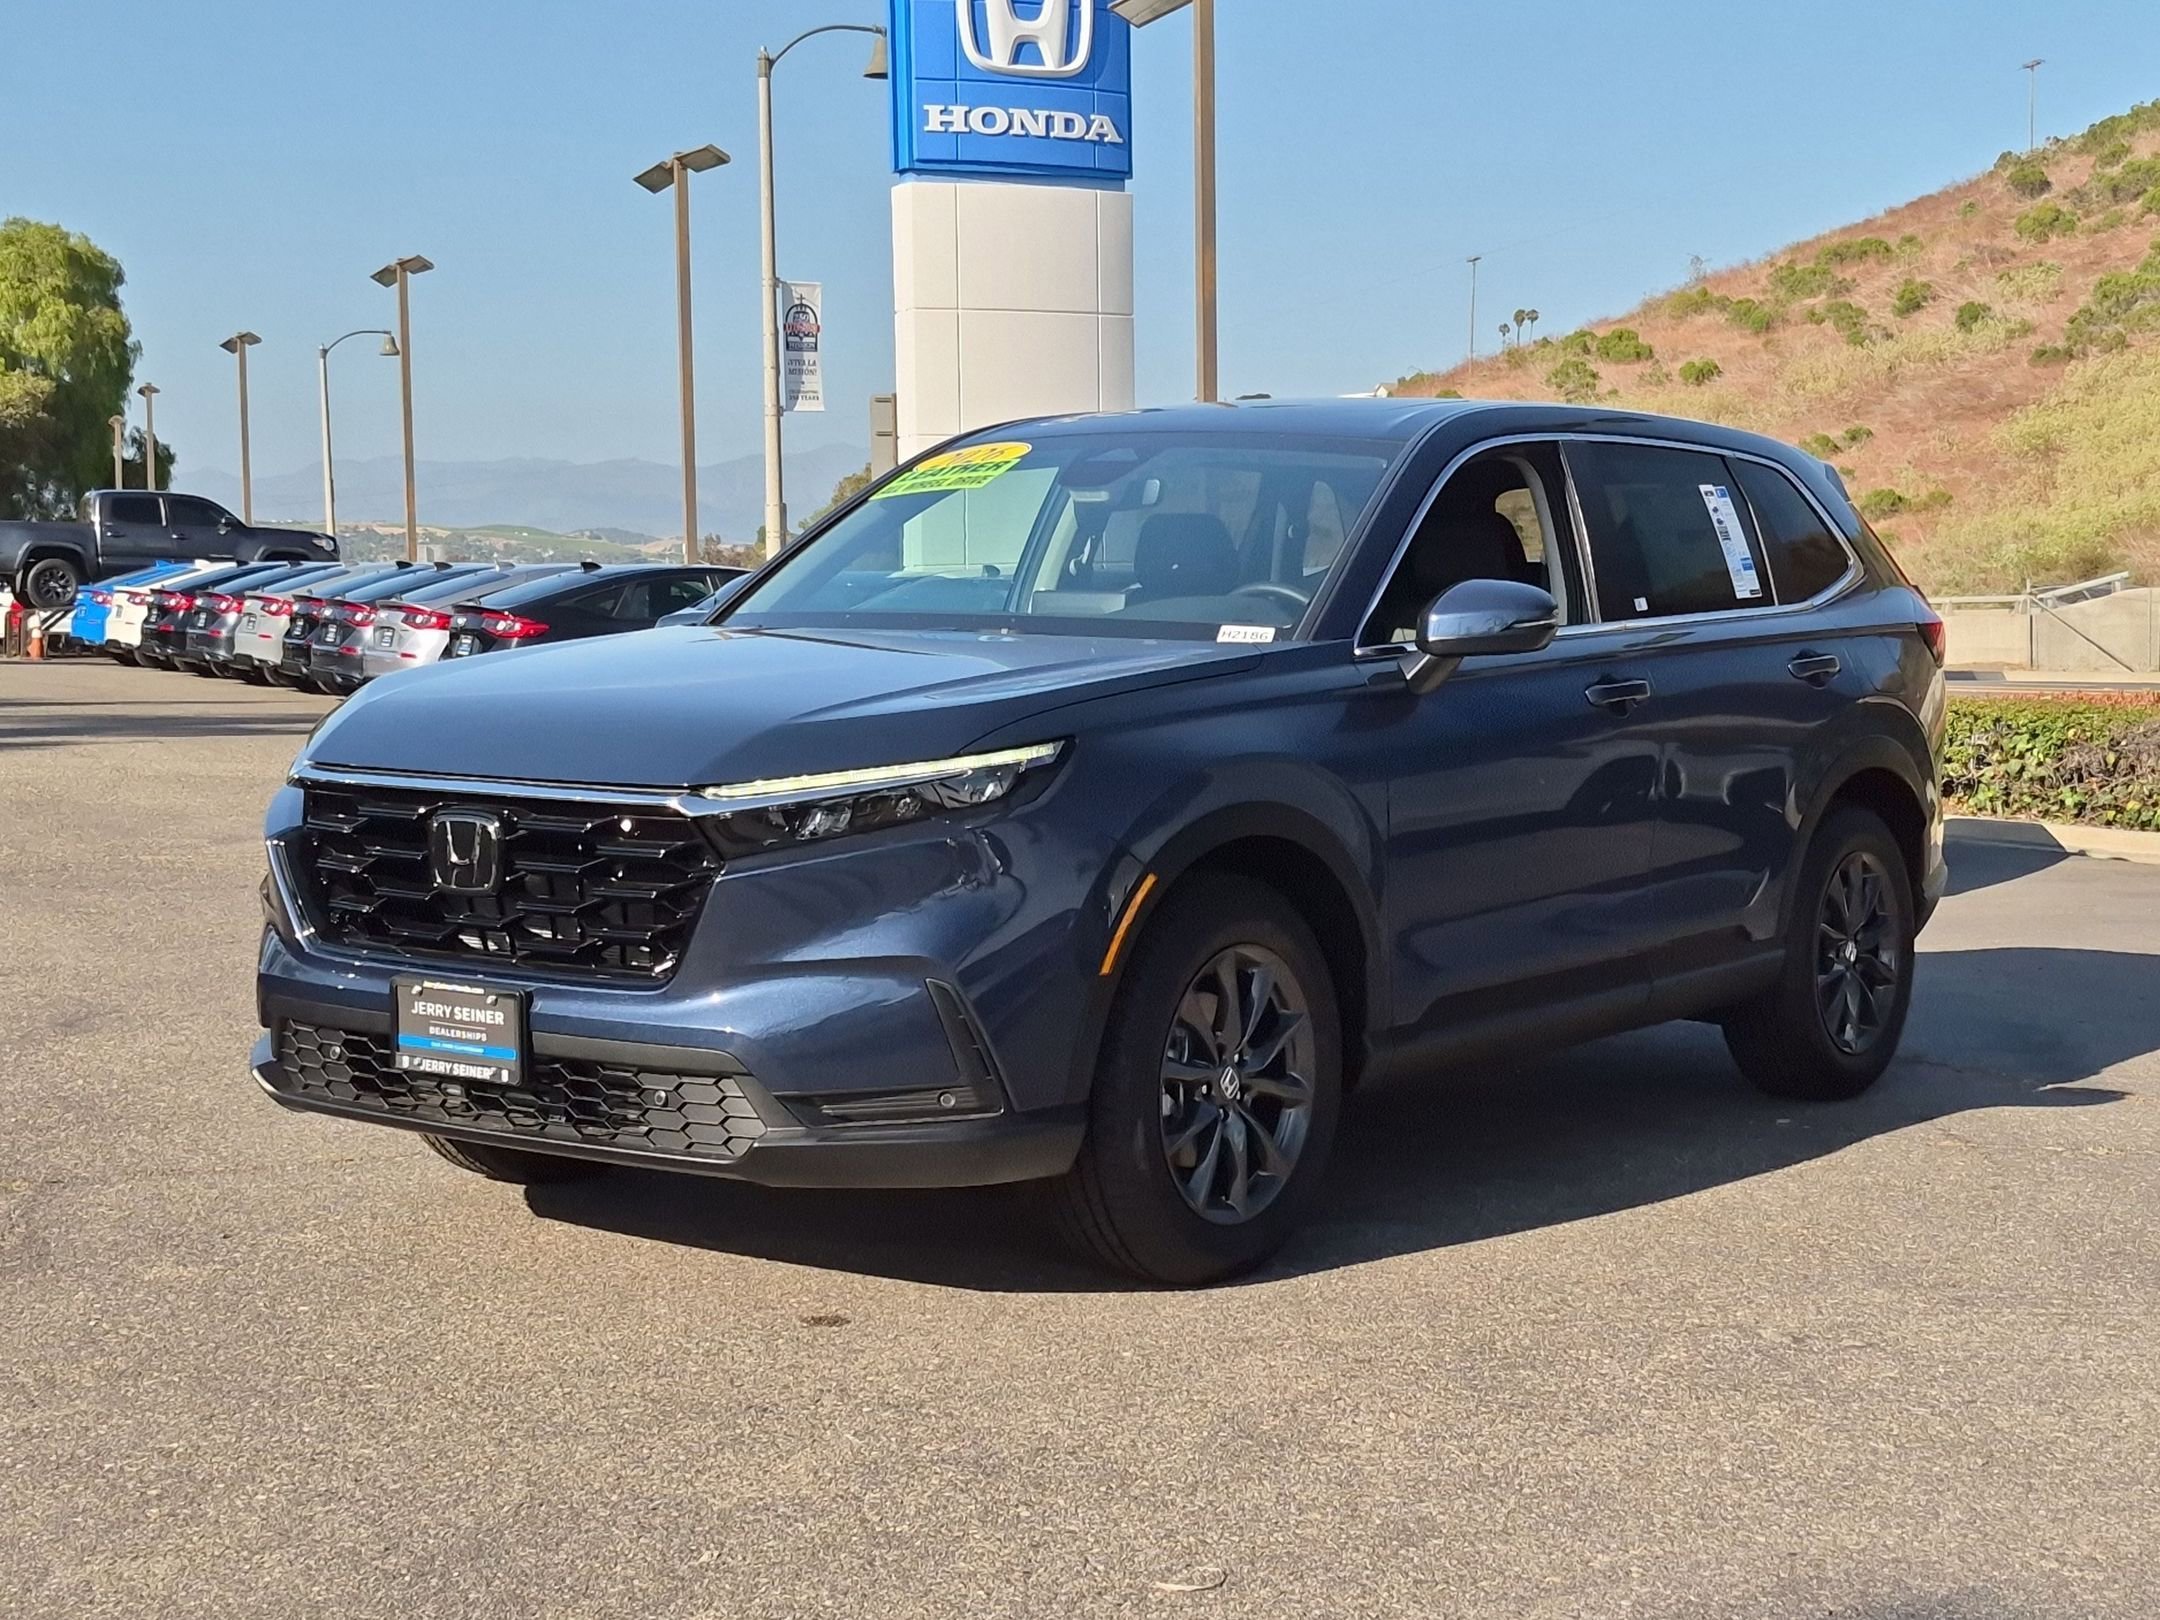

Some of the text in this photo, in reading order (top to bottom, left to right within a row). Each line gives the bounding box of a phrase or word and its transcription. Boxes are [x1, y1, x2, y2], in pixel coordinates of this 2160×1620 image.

[923, 104, 1124, 144] HONDA
[411, 1001, 505, 1025] JERRY SEINER
[429, 1026, 487, 1042] DEALERSHIPS
[419, 1058, 491, 1080] JERRY SEINER
